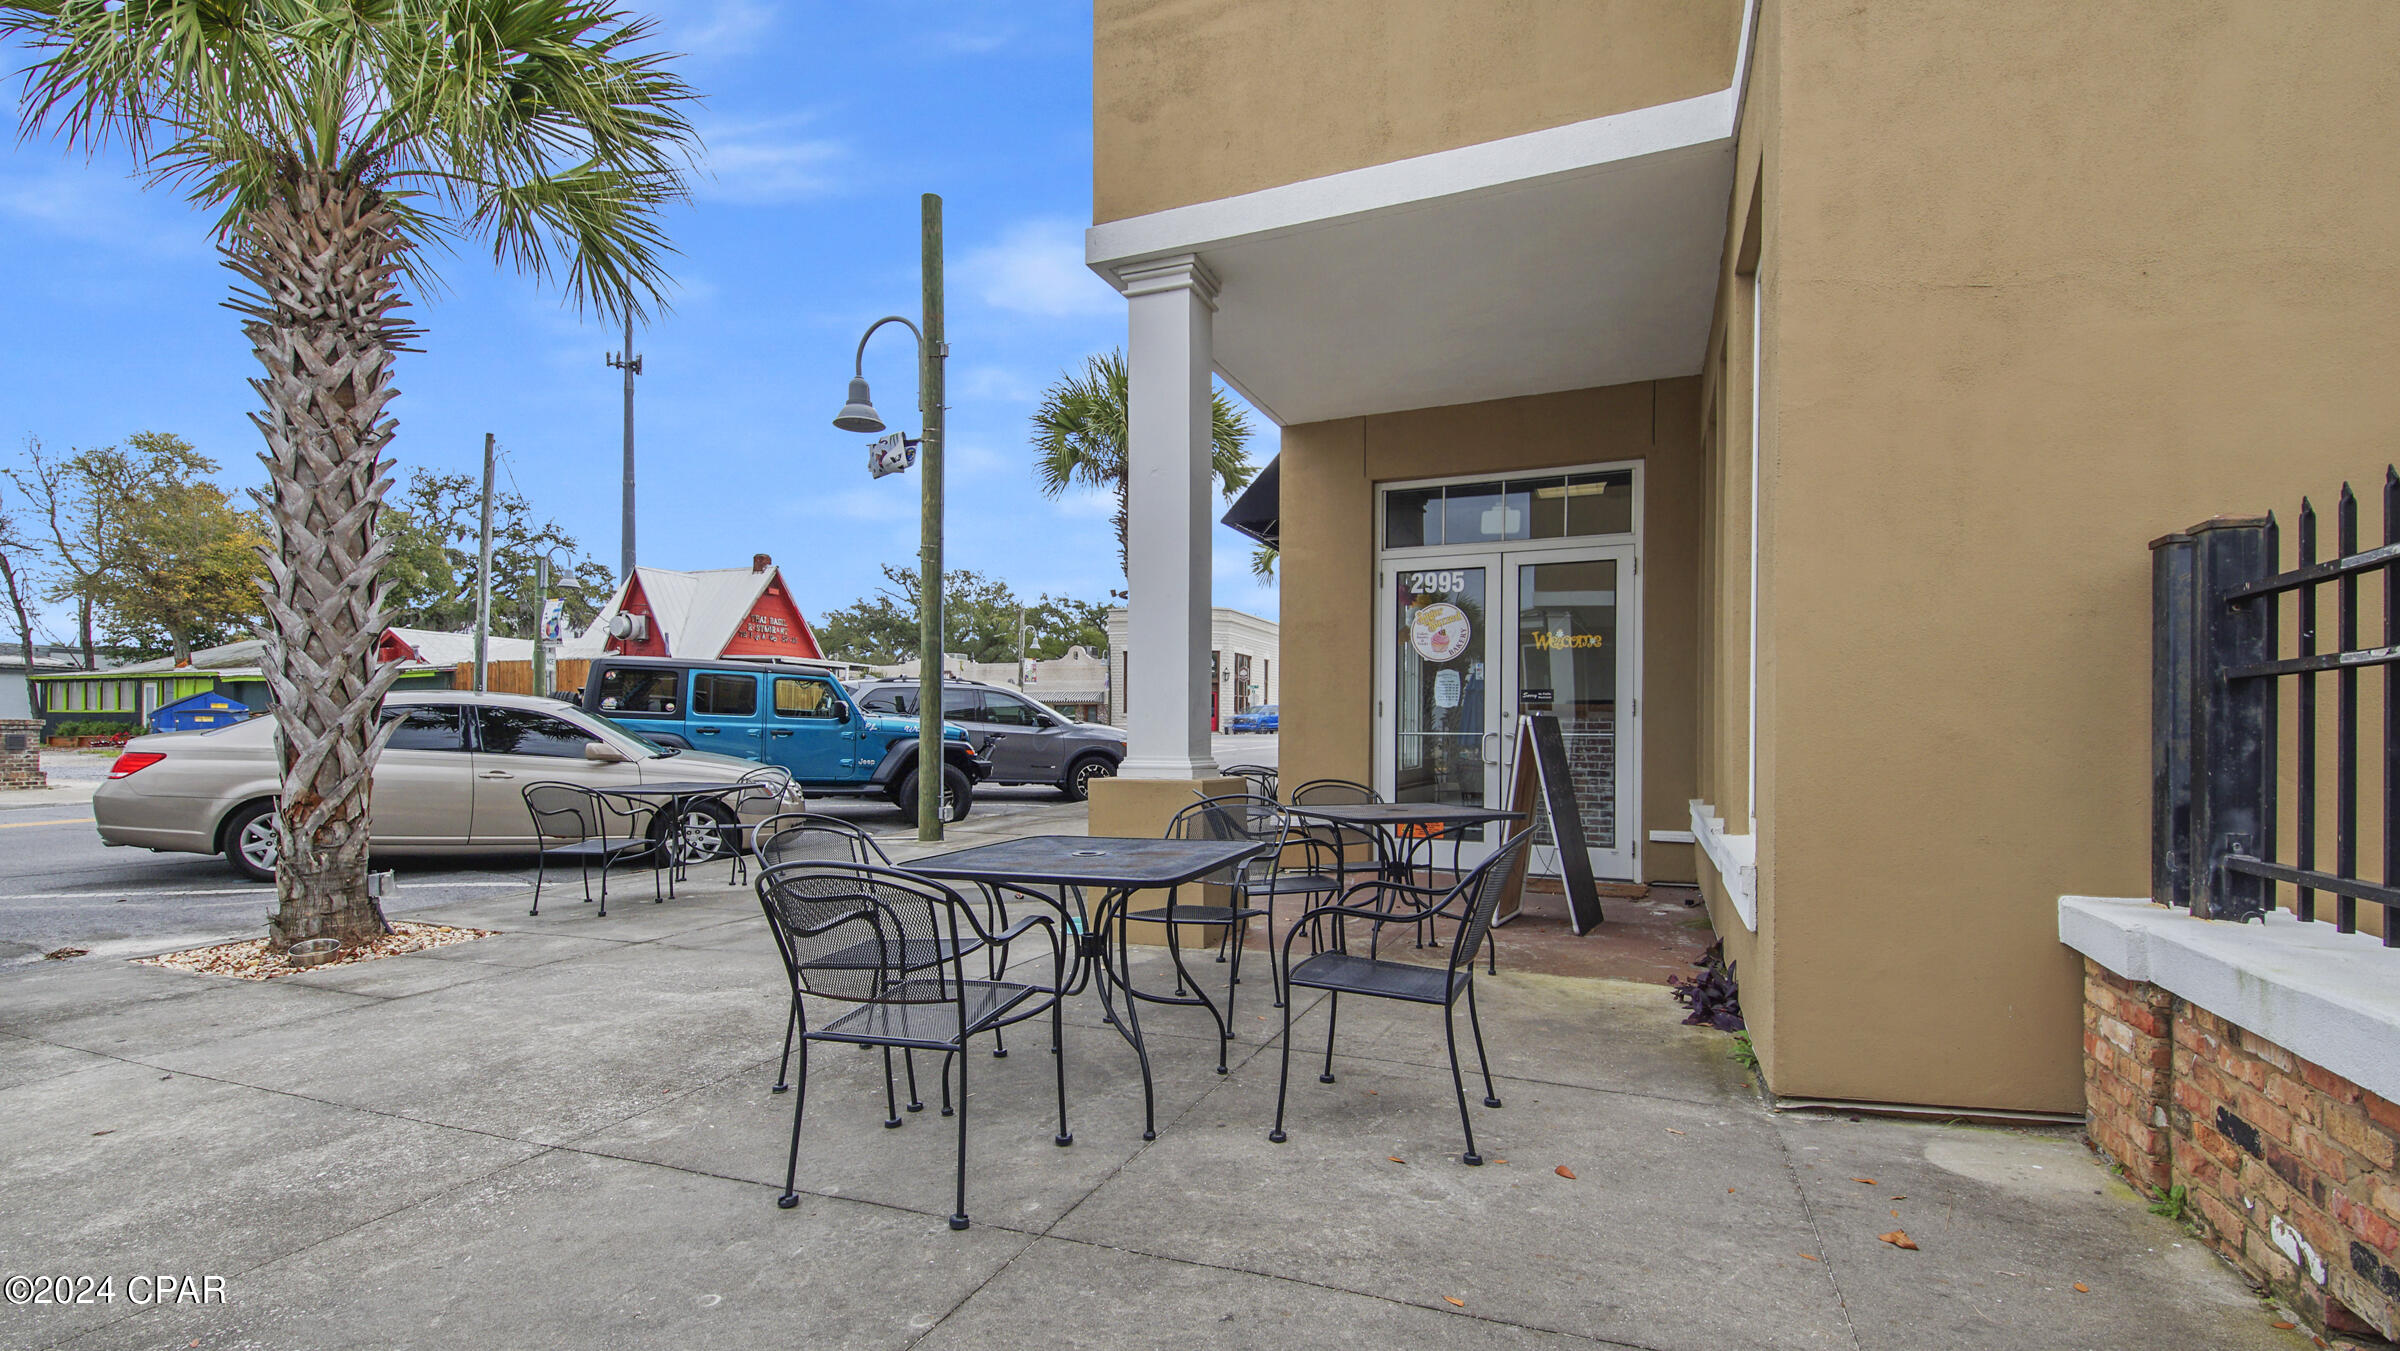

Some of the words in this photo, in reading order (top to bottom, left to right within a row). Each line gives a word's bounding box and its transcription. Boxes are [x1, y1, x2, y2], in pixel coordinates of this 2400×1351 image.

[1411, 571, 1465, 594] 2995
[1448, 628, 1467, 656] BAKERY
[1532, 629, 1602, 651] Welcome
